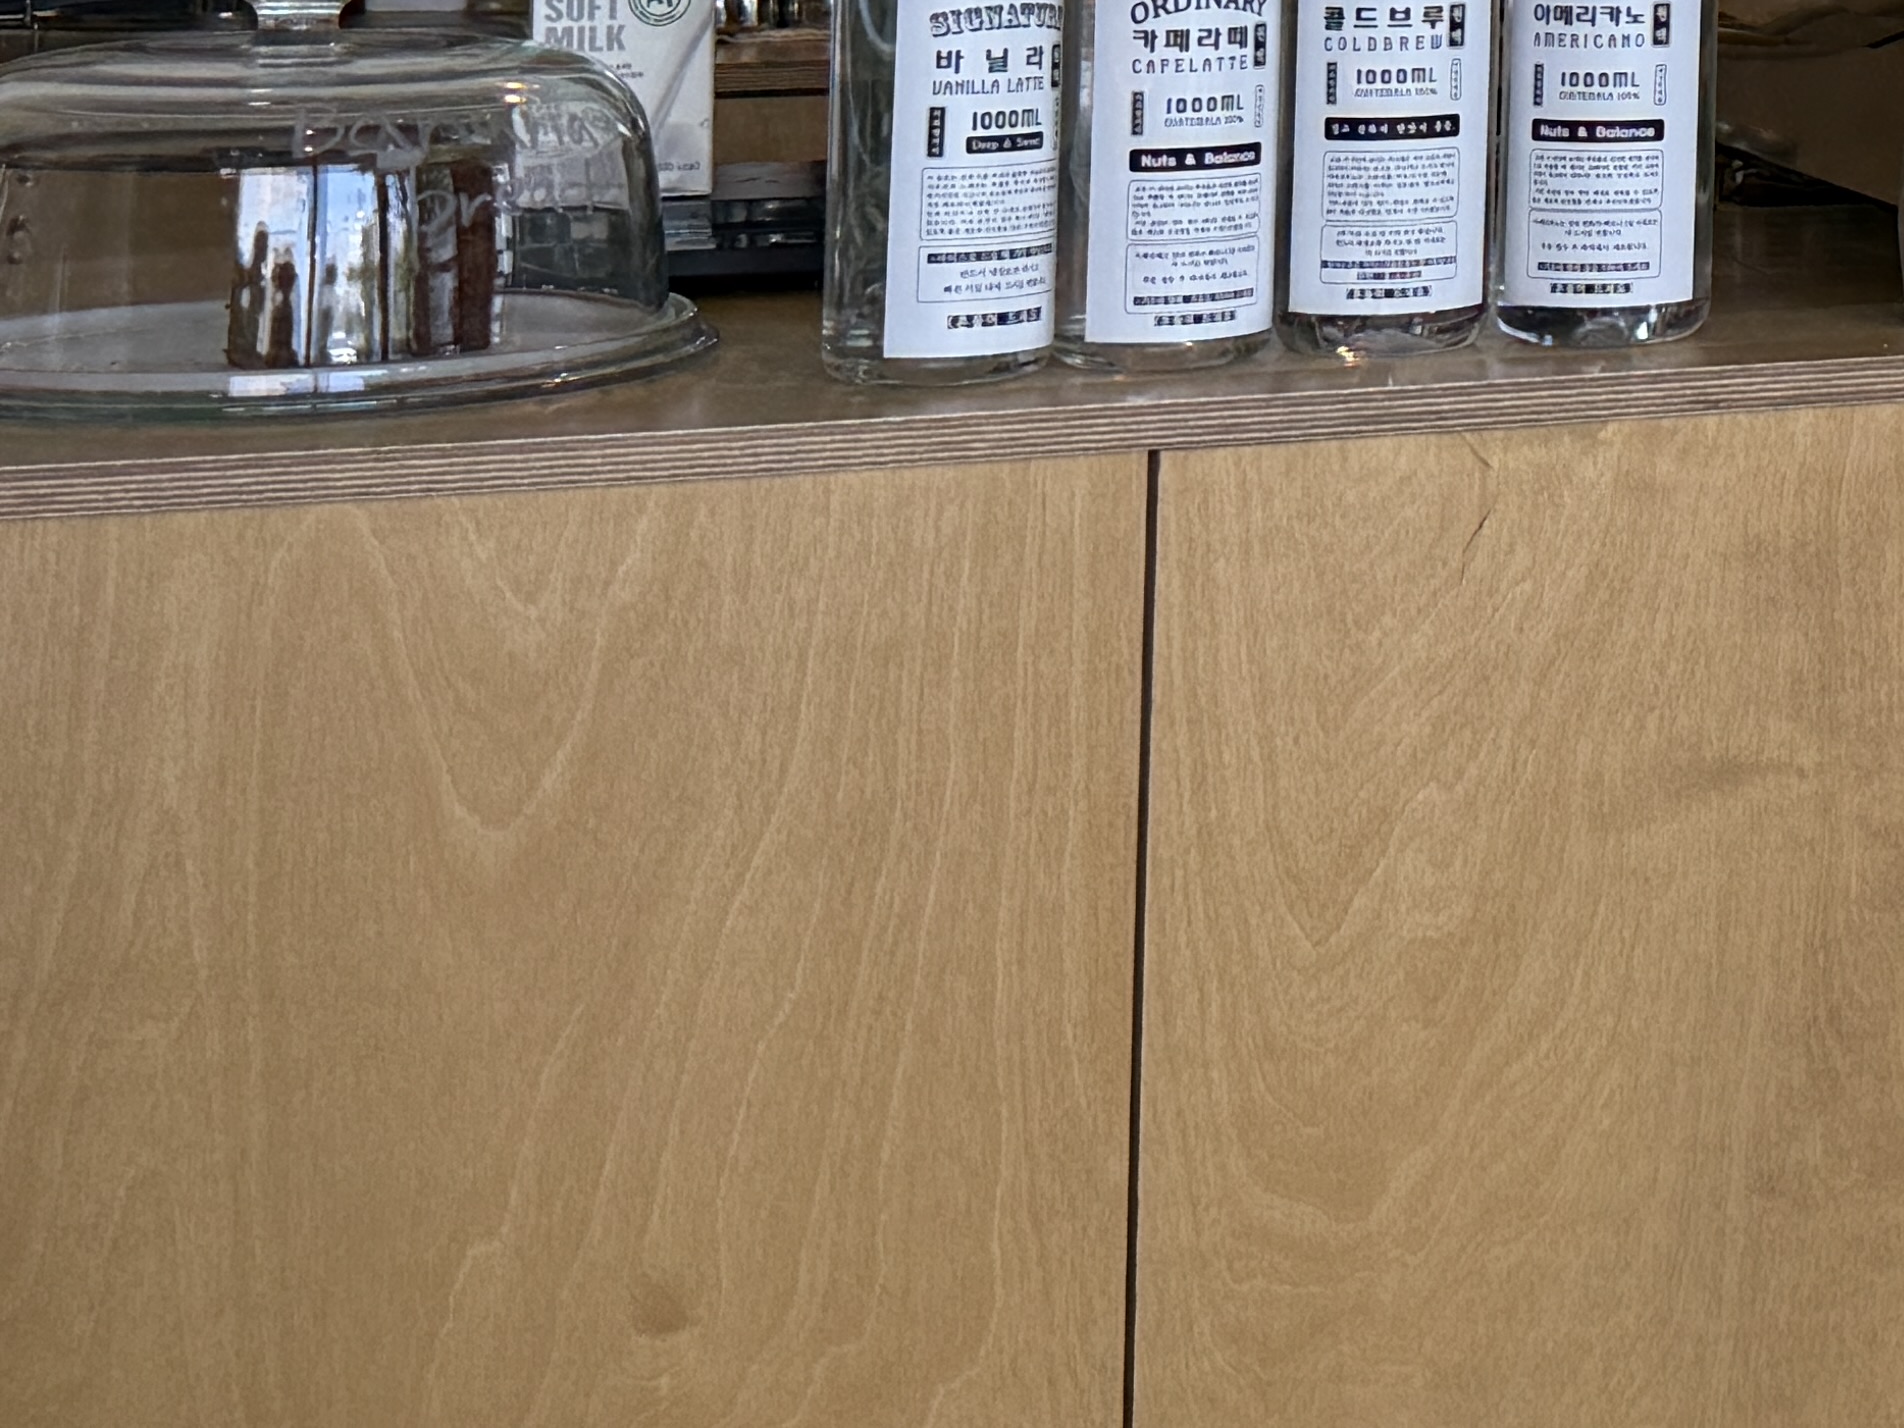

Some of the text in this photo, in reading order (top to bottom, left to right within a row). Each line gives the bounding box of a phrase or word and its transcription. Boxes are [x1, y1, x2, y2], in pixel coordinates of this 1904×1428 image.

[1324, 5, 1444, 32] 콜드브루
[1533, 3, 1646, 27] 아메리카노
[544, 24, 626, 53] MILK
[1132, 25, 1248, 54] 카페라떼
[1324, 34, 1443, 52] COLDBREW
[1533, 32, 1645, 49] AMERICANO
[1132, 54, 1248, 75] CAFELATTE
[932, 75, 1044, 96] VANILLA LATTE
[1356, 67, 1437, 85] 1000ML
[1561, 71, 1640, 88] 1000ML
[1166, 93, 1244, 115] 1000ML
[972, 107, 1042, 131] 1000ML
[1540, 124, 1656, 138] Nuts & Balance
[1141, 151, 1256, 168] Nuts & Balance
